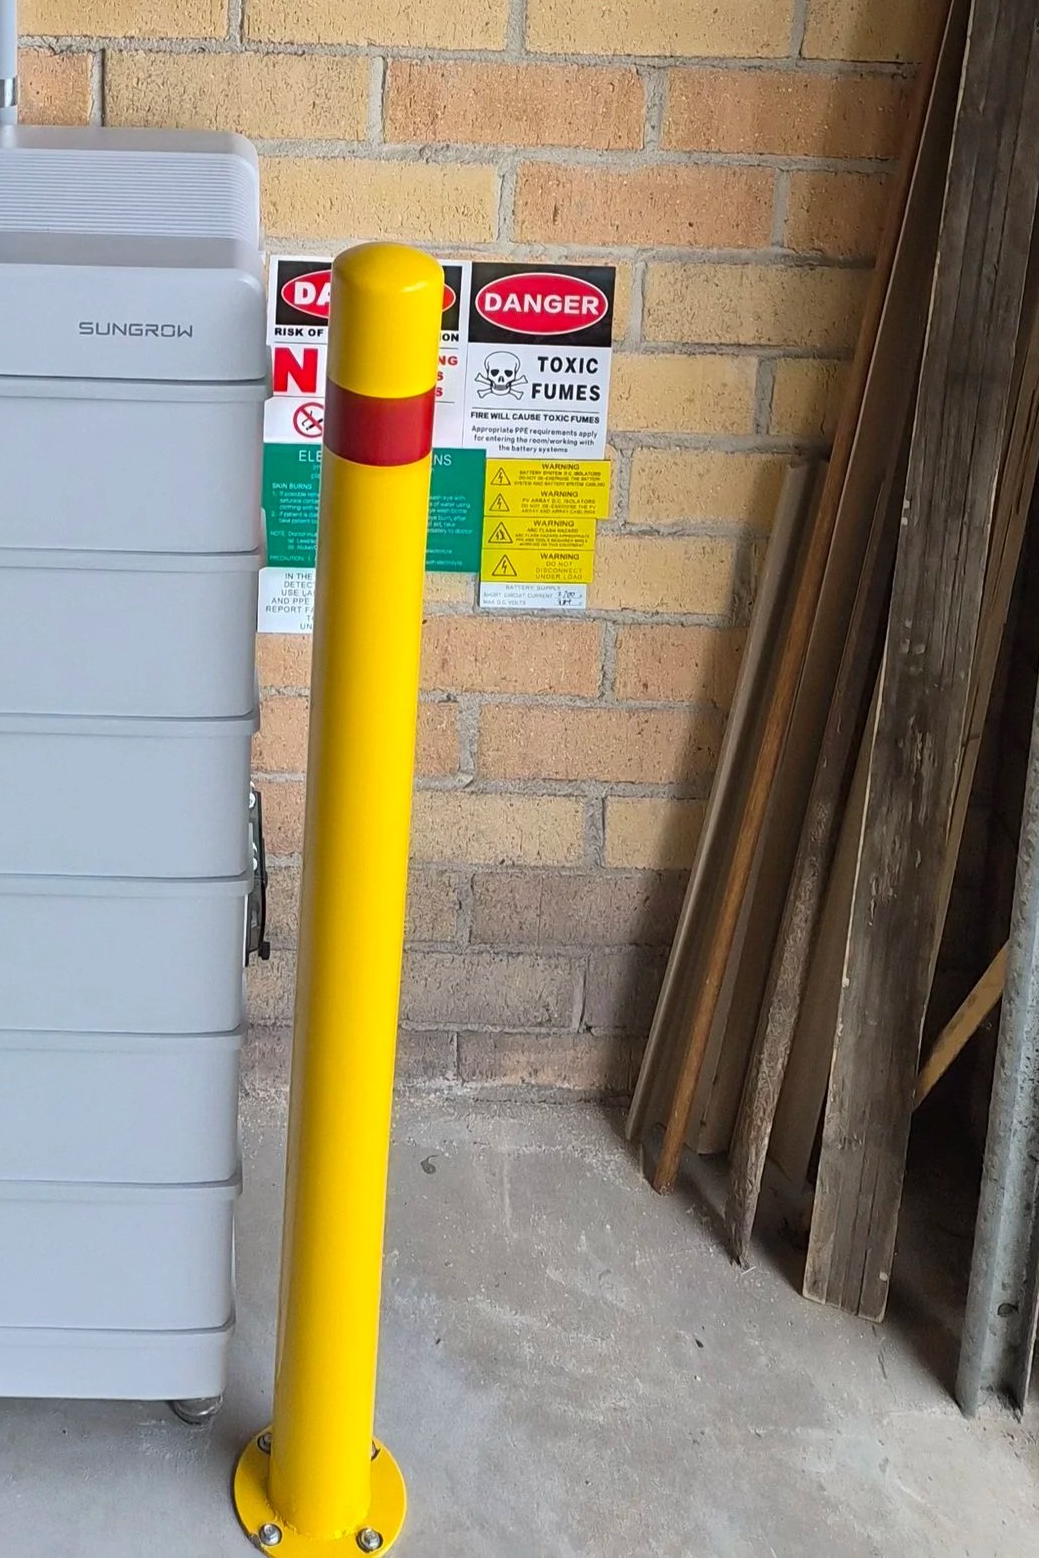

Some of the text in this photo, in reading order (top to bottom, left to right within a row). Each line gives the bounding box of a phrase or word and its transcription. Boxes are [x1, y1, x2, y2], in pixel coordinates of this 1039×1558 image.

[484, 292, 600, 315] DANGER
[79, 322, 193, 338] SUNGROW
[274, 328, 324, 337] RISK OF
[274, 346, 318, 393] N
[538, 356, 599, 374] TOXIC
[532, 383, 601, 402] FUMES
[470, 411, 600, 424] FIRE WILL CAUSE TOXIC FUMES
[472, 425, 514, 434] Appropriate
[530, 428, 578, 438] requirements
[578, 430, 598, 438] apply
[486, 435, 515, 444] entering
[528, 436, 578, 446] room/working
[511, 445, 537, 454] battery
